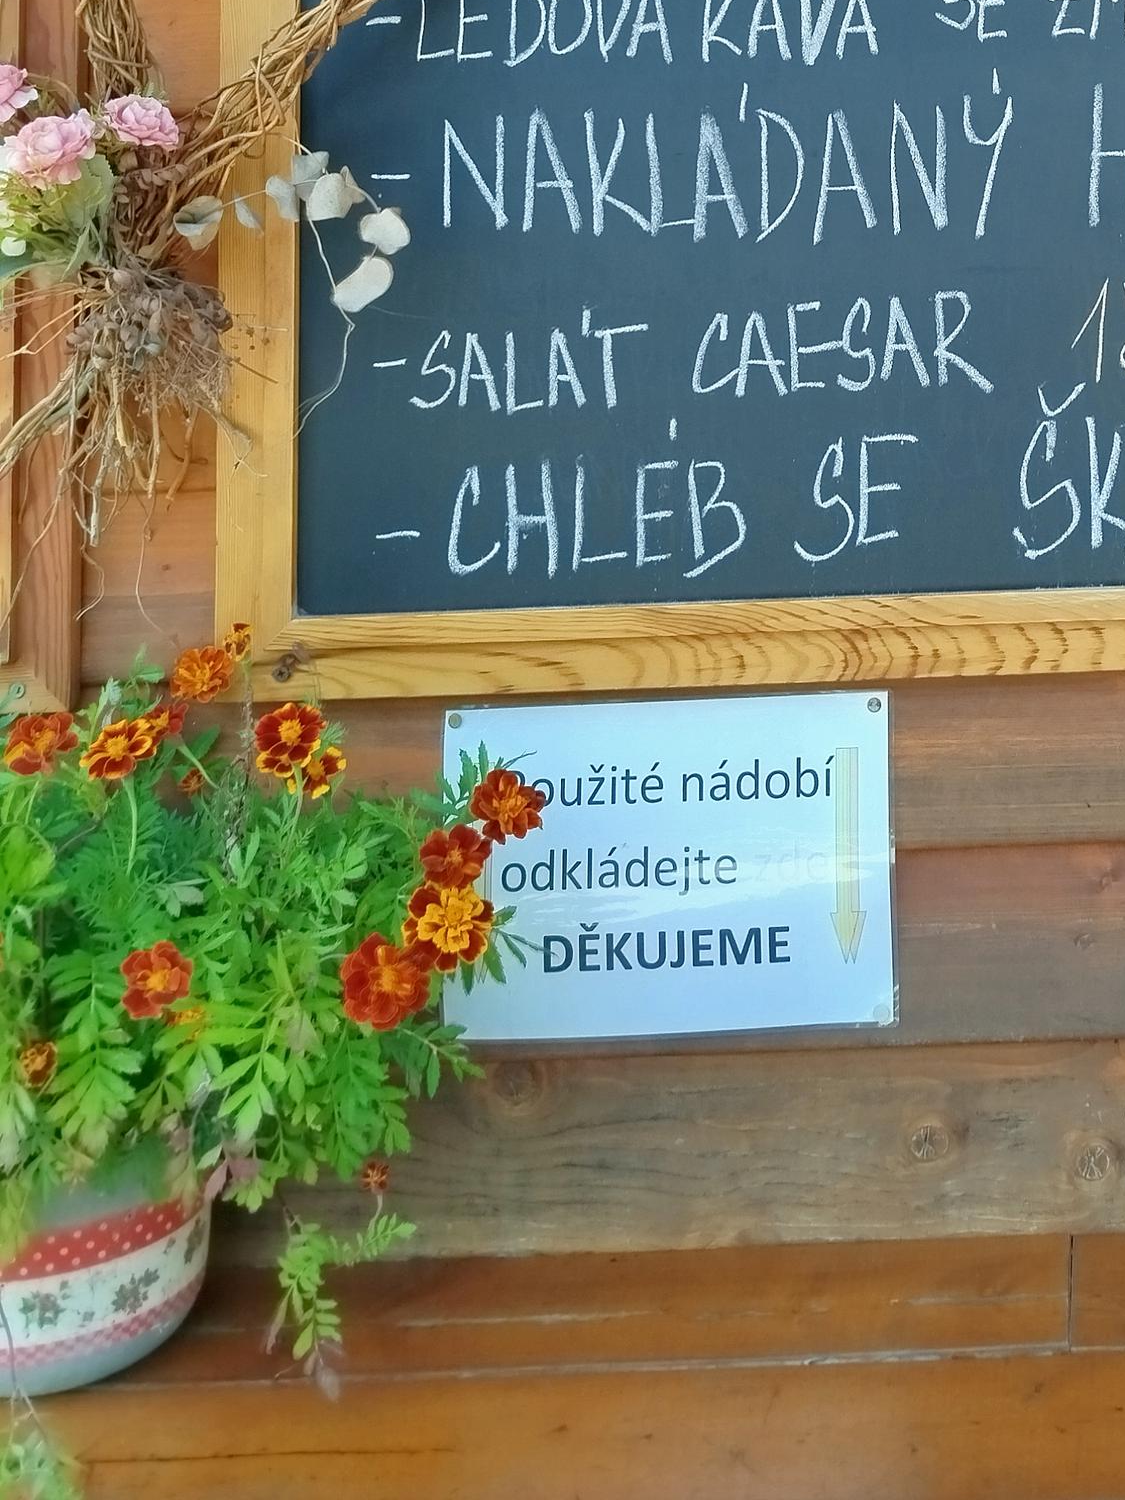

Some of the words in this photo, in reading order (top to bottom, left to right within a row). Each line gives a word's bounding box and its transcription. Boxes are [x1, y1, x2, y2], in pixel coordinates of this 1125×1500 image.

[690, 291, 994, 397] CAESAR
[794, 434, 918, 562] SE
[510, 761, 665, 808] oužité
[681, 754, 836, 804] nádobí
[500, 844, 739, 897] odkládejte
[542, 921, 792, 974] DĚKUJEME
